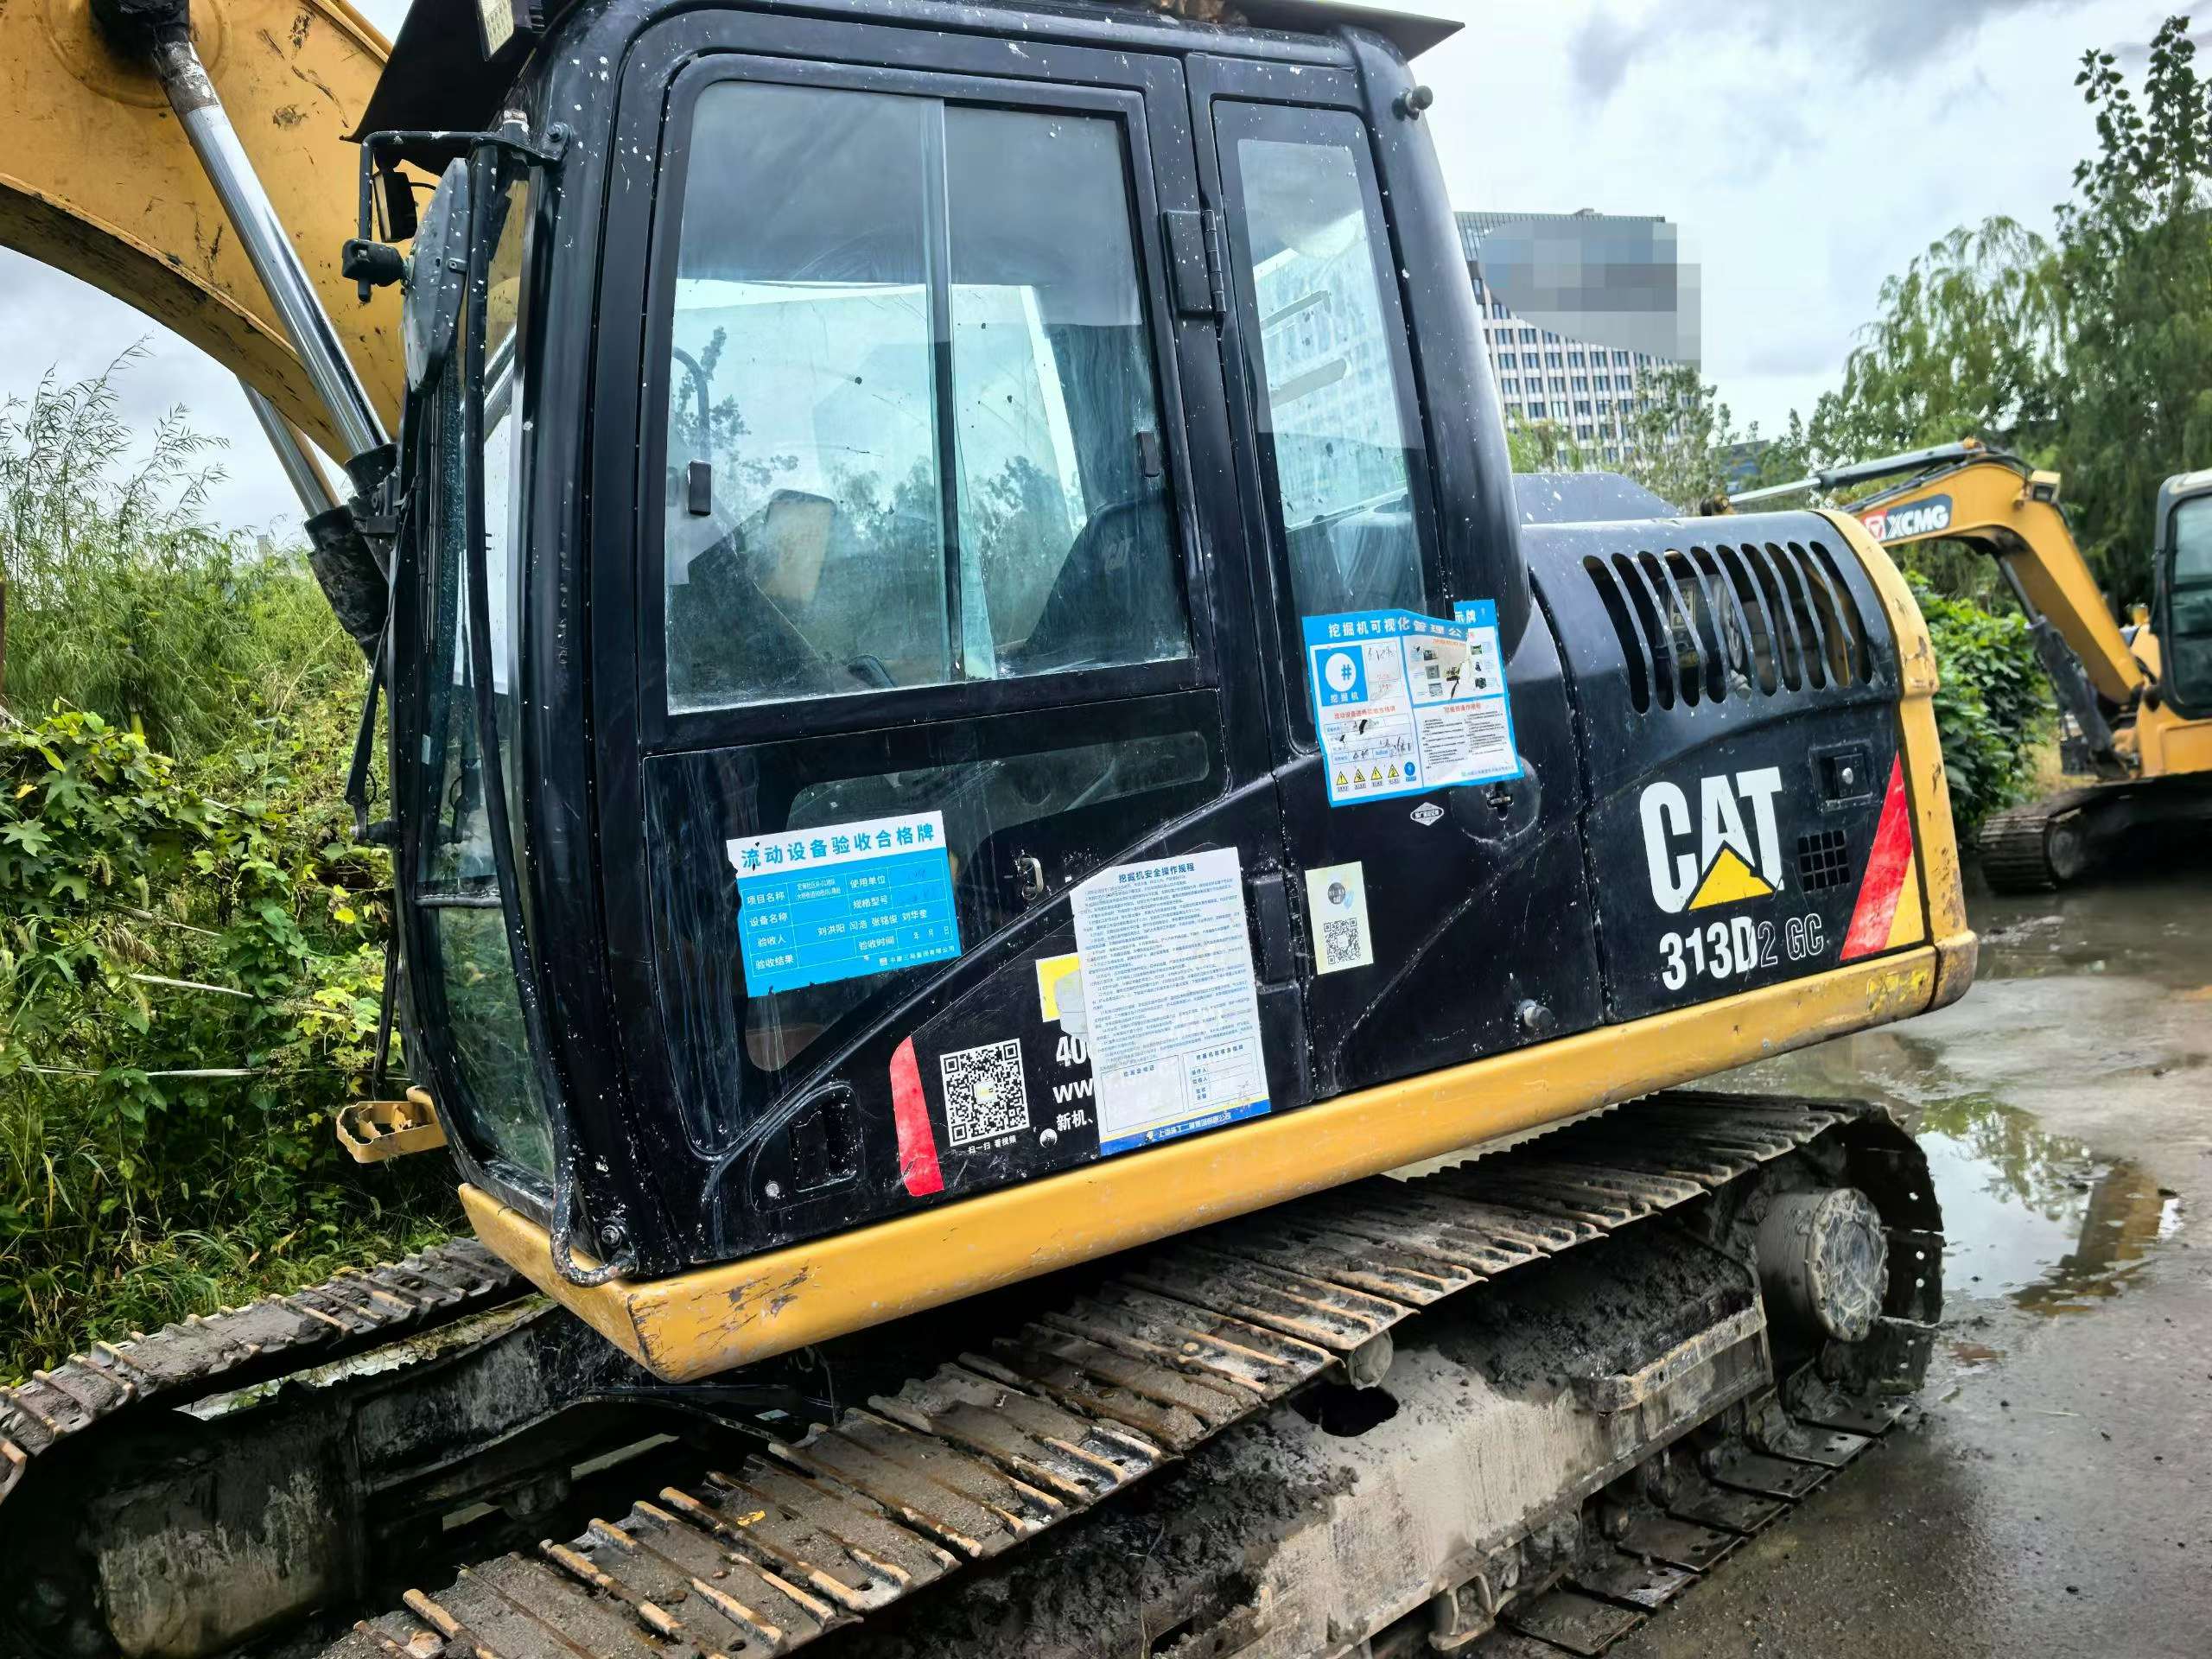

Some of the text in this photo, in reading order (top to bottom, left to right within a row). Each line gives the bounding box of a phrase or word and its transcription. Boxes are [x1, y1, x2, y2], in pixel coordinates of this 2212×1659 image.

[1886, 505, 1949, 539] XCMG
[1331, 692, 1359, 703] 挖掘机
[741, 823, 935, 868] 流动设备验收合格牌
[1640, 766, 1784, 914] CAT
[1118, 862, 1196, 883] 挖掘机安全操作规程
[850, 875, 886, 890] 使用单位
[747, 891, 785, 906] 项目名称
[853, 895, 889, 910] 规格型号
[750, 912, 788, 927] 设备名称
[757, 934, 786, 948] 验收人
[859, 936, 894, 950] 验收时间
[1785, 912, 1824, 961] GC
[755, 954, 794, 970] 验收结果
[1056, 1036, 1091, 1067] 40
[968, 1142, 991, 1154] 扫一扫
